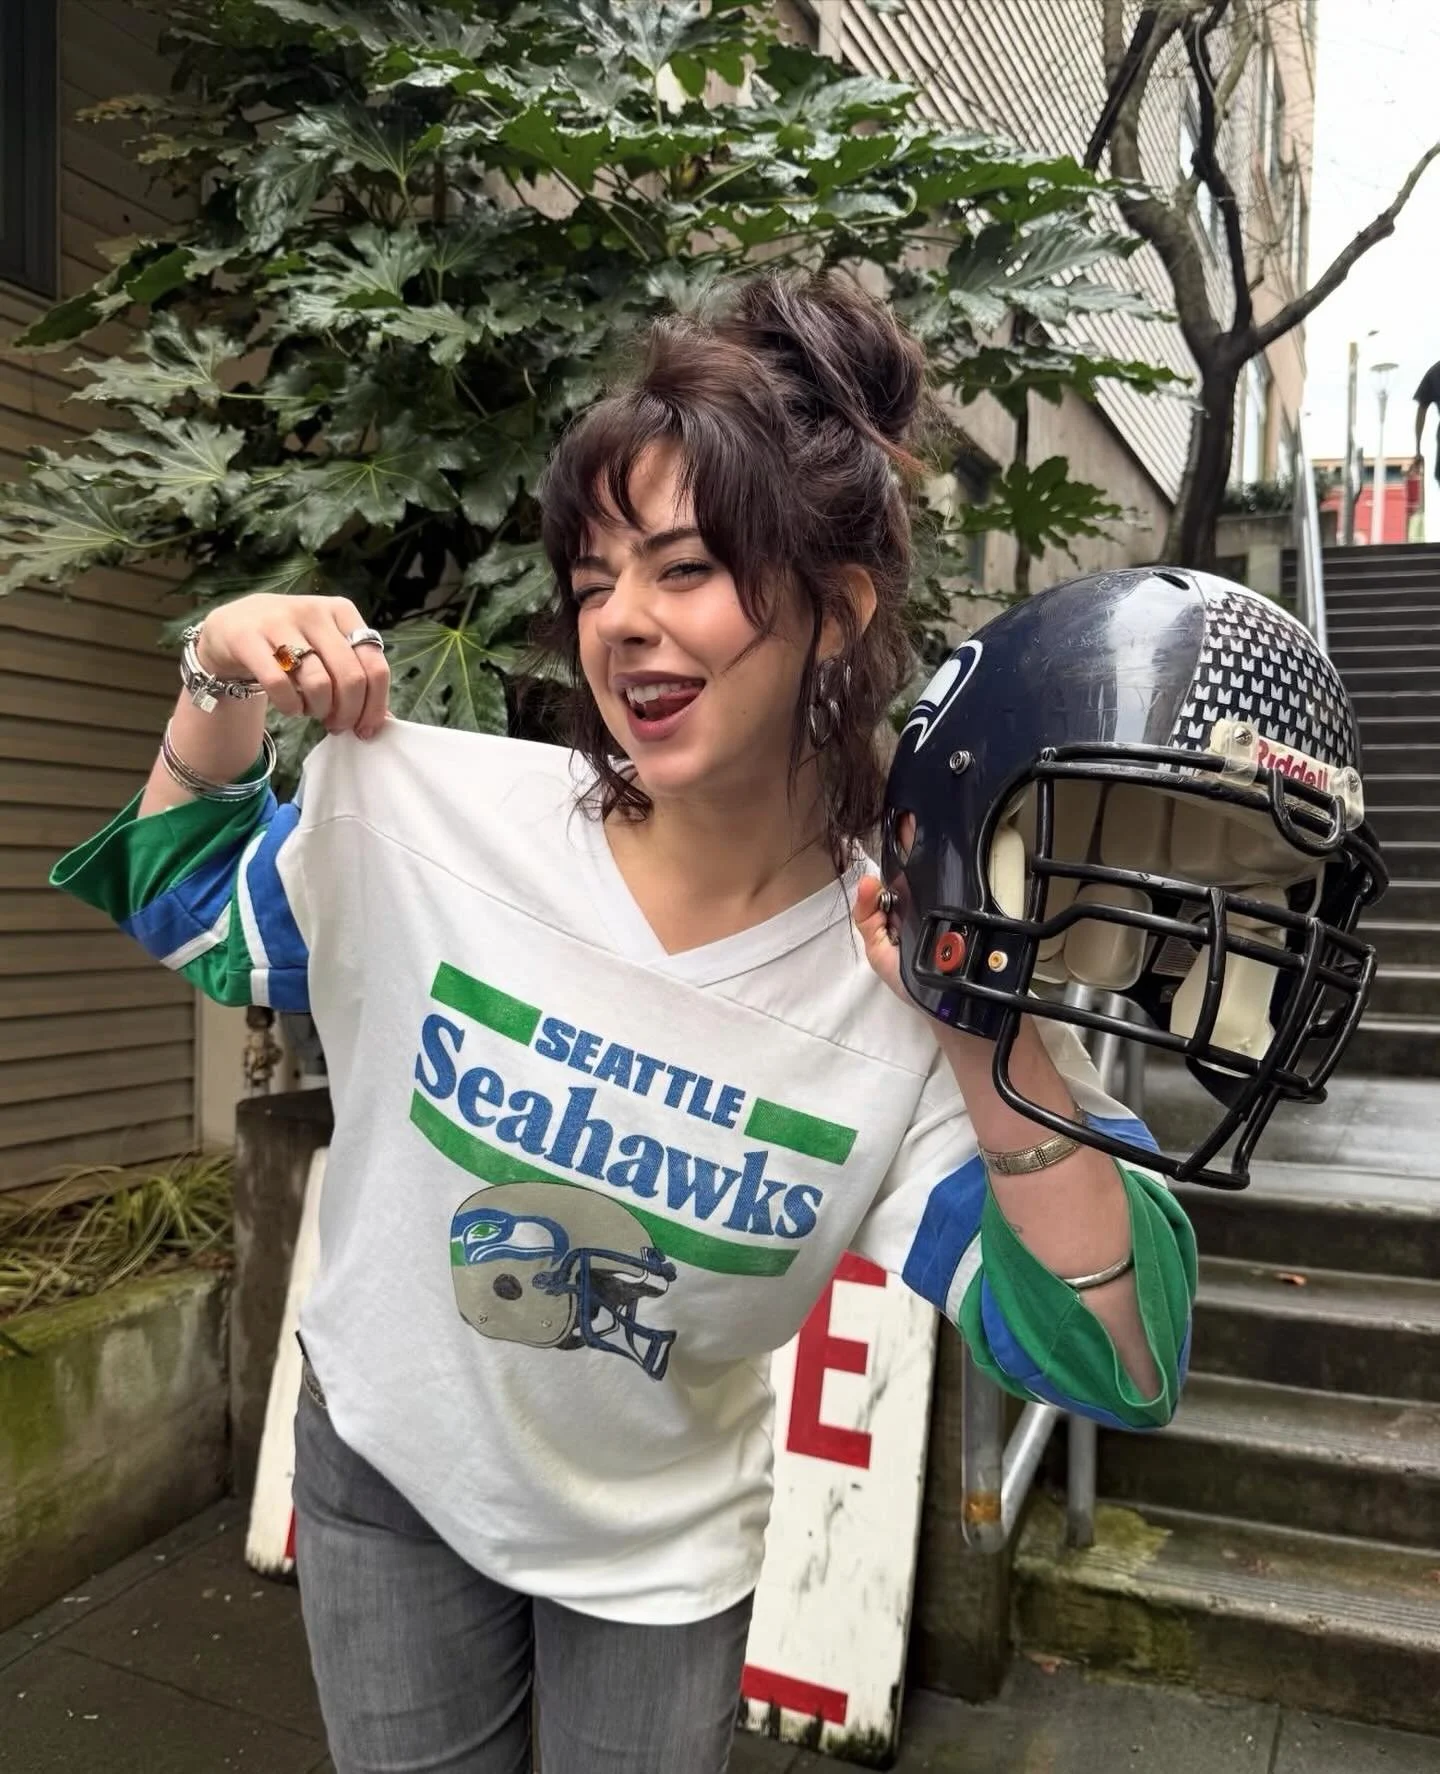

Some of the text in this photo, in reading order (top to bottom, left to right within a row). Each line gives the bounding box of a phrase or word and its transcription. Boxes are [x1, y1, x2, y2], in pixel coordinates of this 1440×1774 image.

[1256, 739, 1329, 792] Riddell
[413, 1012, 824, 1240] Seahawks
[534, 1016, 747, 1130] SEATTLE
